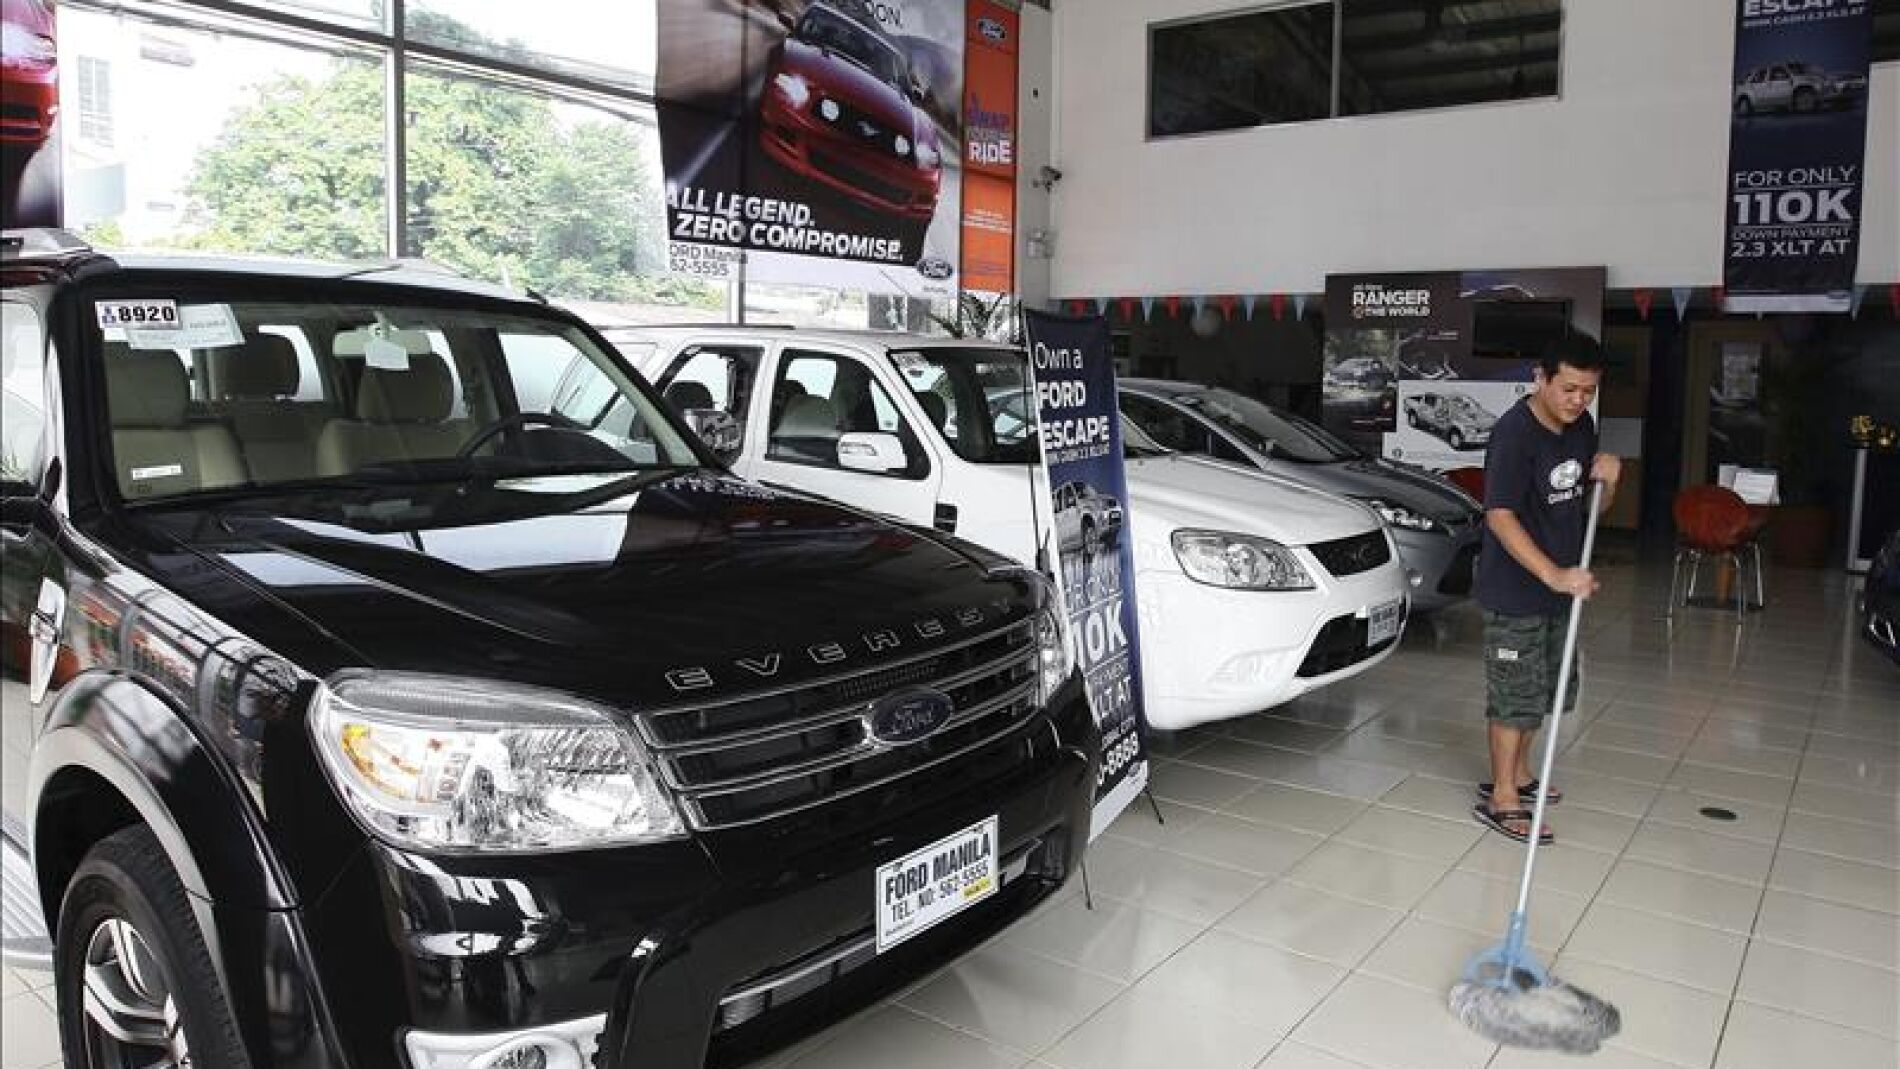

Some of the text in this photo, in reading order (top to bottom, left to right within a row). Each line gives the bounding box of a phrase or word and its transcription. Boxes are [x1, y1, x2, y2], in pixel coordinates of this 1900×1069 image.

[968, 139, 1011, 164] RIDE
[1735, 166, 1855, 188] FOR ONLY
[667, 184, 816, 227] ALL LEGEND.
[1733, 189, 1853, 225] 110K
[674, 213, 903, 261] ZERO COMPROMISE.
[1731, 239, 1851, 258] 2.3 XLT AT
[1353, 289, 1430, 305] RANGER
[118, 305, 174, 321] 8920
[1035, 341, 1084, 369] Own a
[1037, 381, 1087, 410] FORD
[1040, 415, 1110, 451] ESCAPE
[885, 861, 928, 906] FORD
[932, 833, 991, 882] MANILA
[892, 900, 915, 922] TEL.
